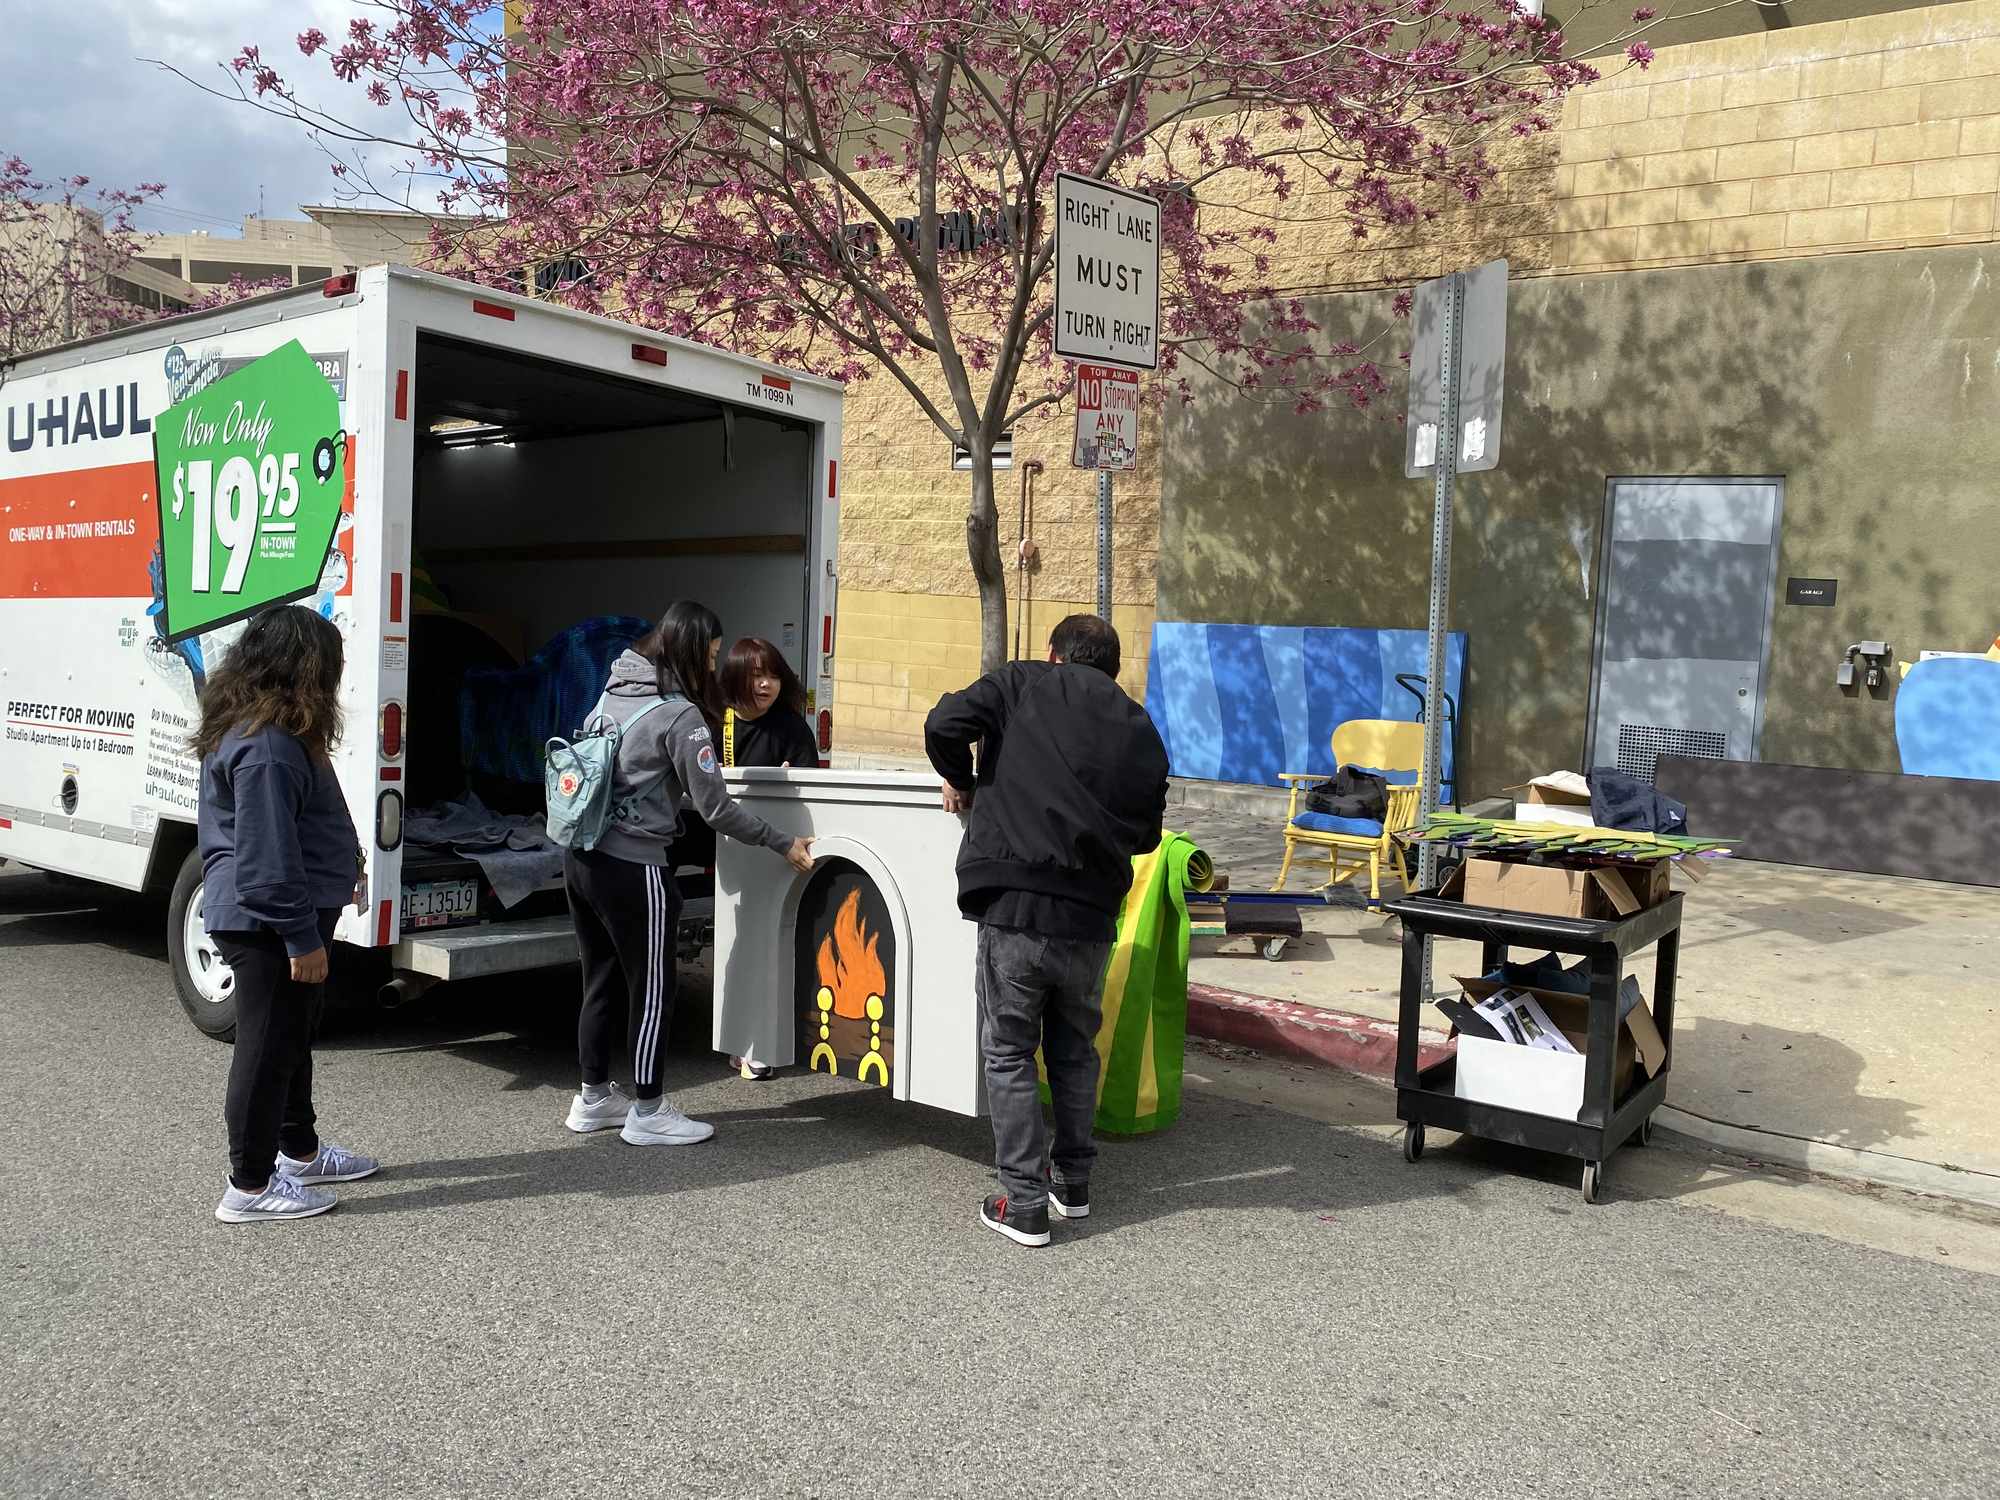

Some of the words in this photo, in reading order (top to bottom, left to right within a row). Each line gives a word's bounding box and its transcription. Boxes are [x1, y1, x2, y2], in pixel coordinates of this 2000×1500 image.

[1065, 197, 1110, 231] RIGHT
[1117, 212, 1153, 243] LANE
[1077, 254, 1143, 295] MUST
[1065, 310, 1105, 339] TURN
[1113, 319, 1151, 347] RIGHT
[167, 354, 184, 375] #125
[1089, 366, 1107, 378] TOW
[1111, 370, 1131, 381] AWAY
[745, 382, 761, 398] TM
[763, 388, 785, 403] 1099
[786, 393, 794, 406] N
[1081, 378, 1100, 408] NO
[1104, 385, 1136, 411] STOPPING
[179, 406, 220, 449] Now
[222, 400, 275, 459] Only
[1095, 411, 1125, 432] ANY
[9, 526, 46, 543] ONE-WAY
[46, 525, 54, 541] &
[55, 522, 94, 541] IN-TOWN
[94, 519, 136, 537] RENTALS
[260, 536, 297, 550] IN-TOWN
[7, 700, 58, 721] PERFECT
[59, 706, 83, 724] FOR
[85, 708, 135, 730] MOVING
[71, 734, 82, 751] Up
[82, 738, 91, 750] to
[98, 739, 134, 756] Bedroom
[425, 889, 473, 915] 13519
